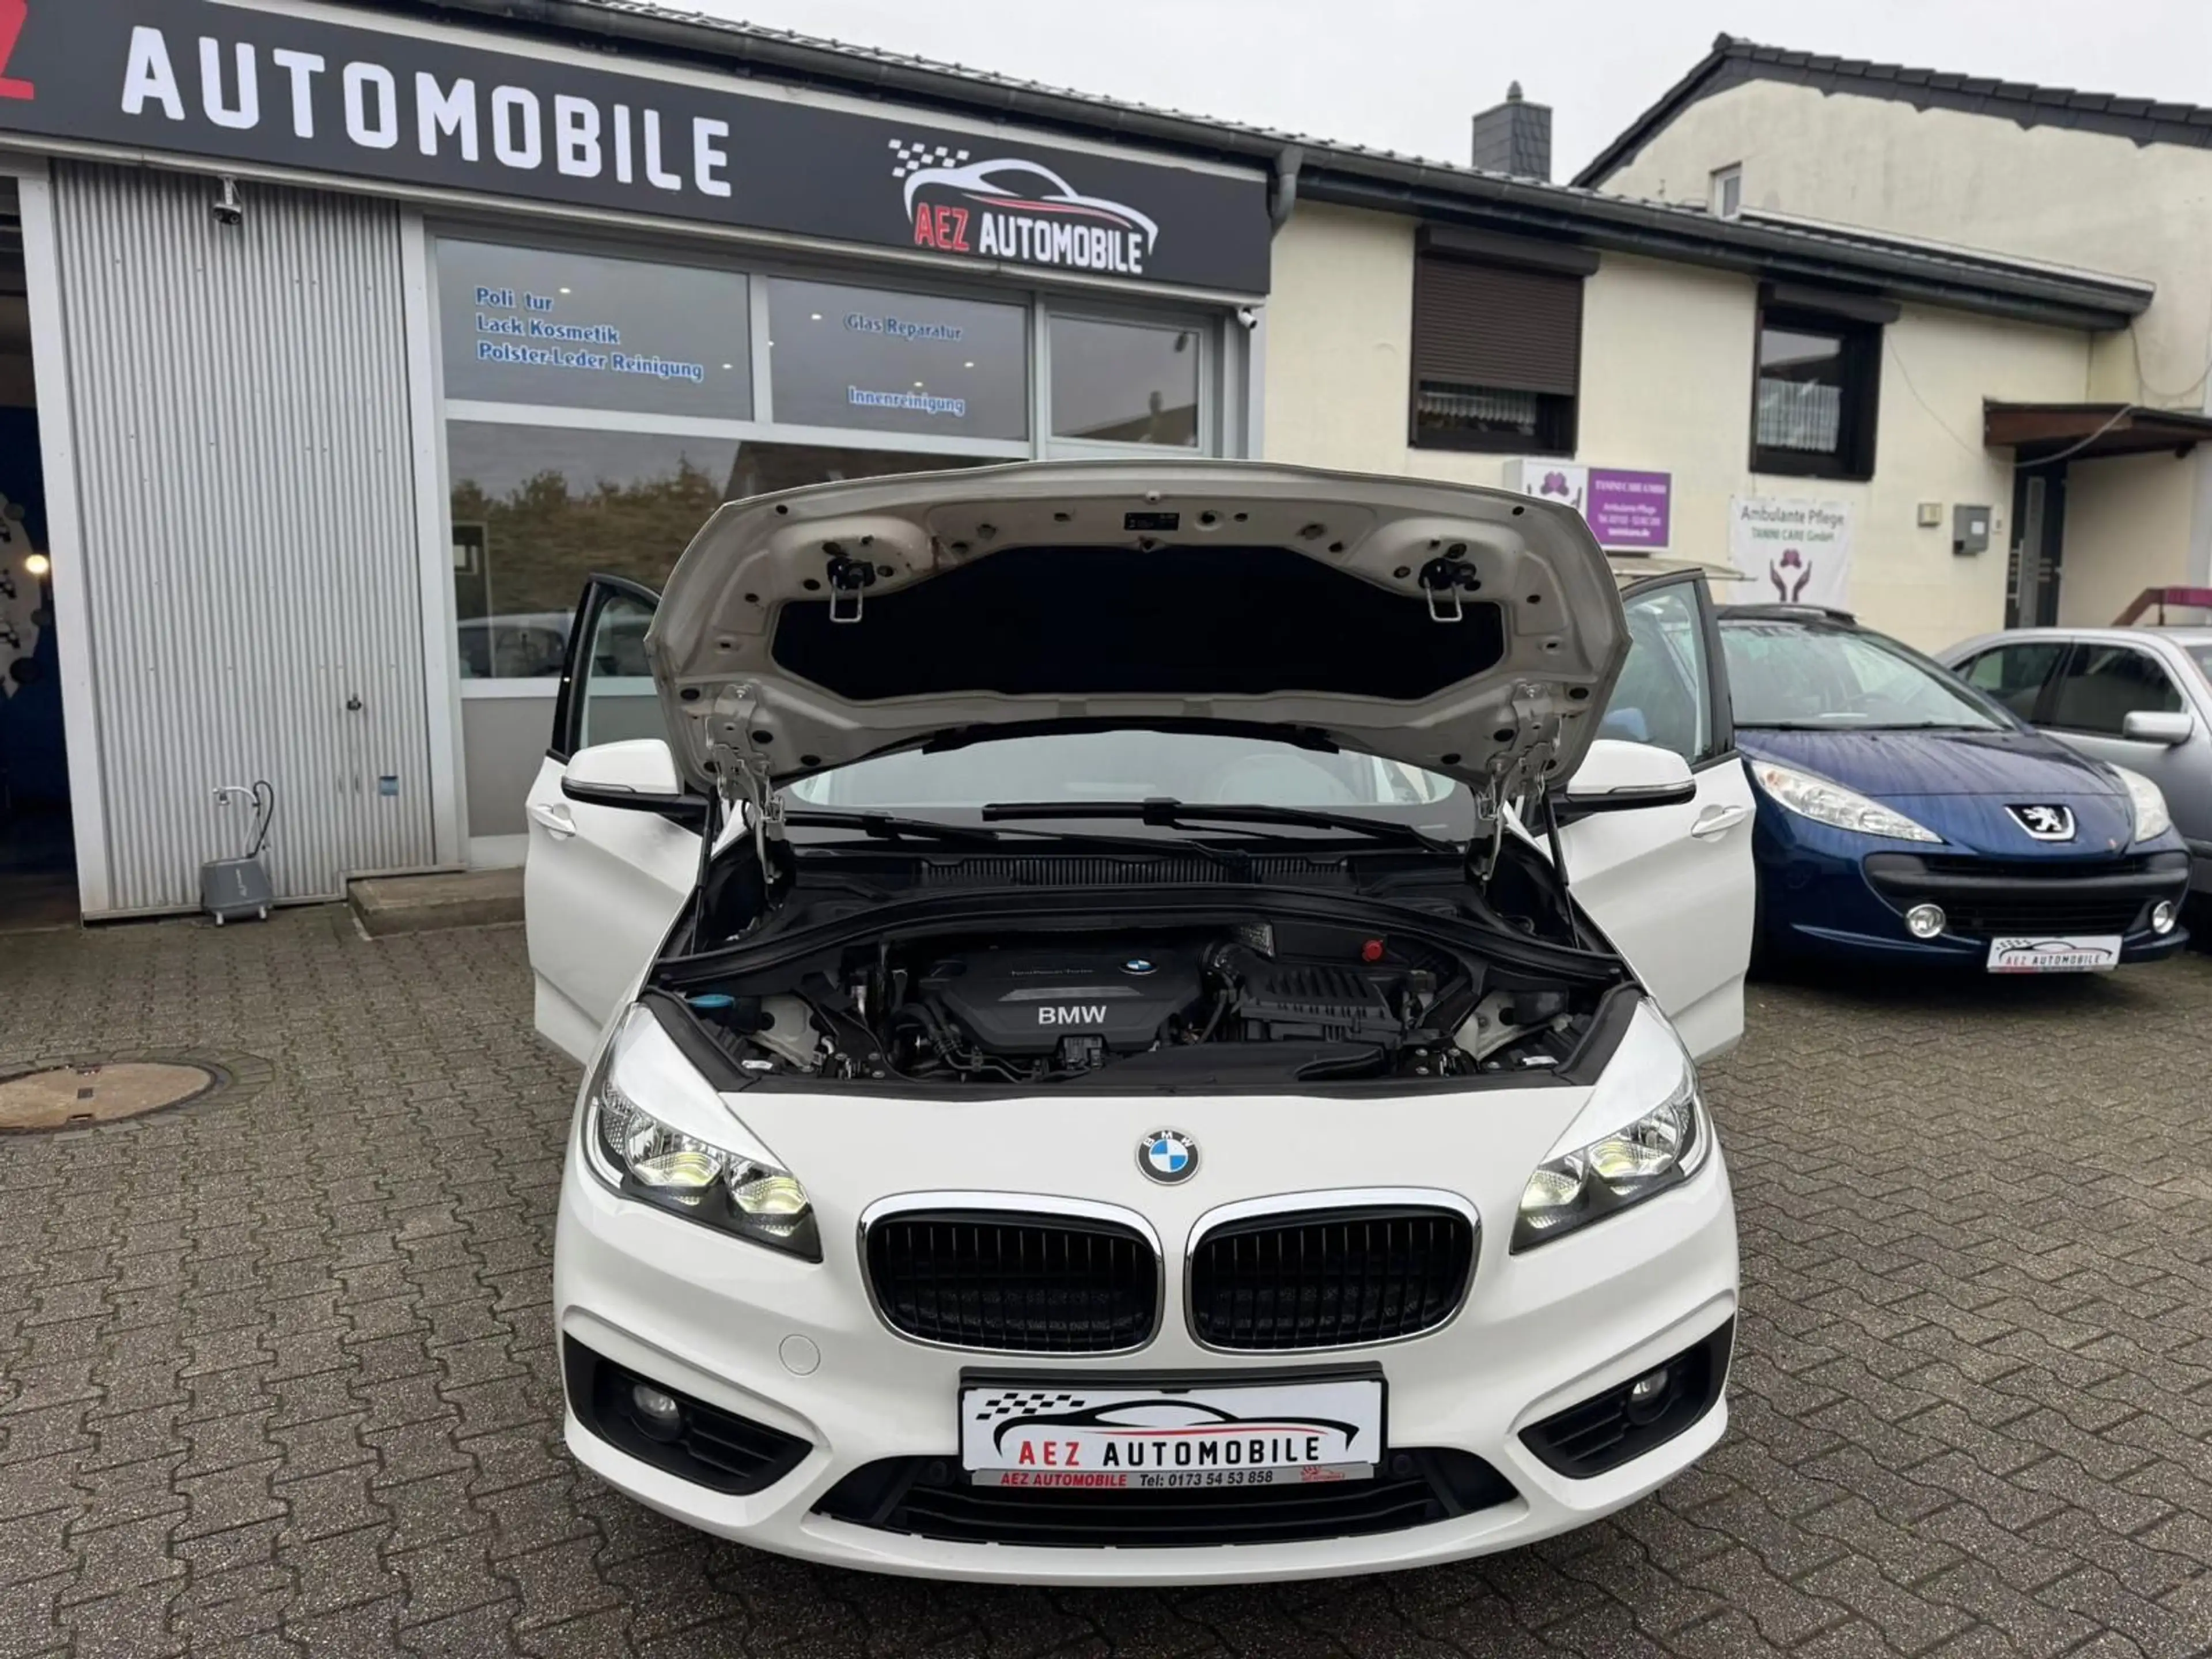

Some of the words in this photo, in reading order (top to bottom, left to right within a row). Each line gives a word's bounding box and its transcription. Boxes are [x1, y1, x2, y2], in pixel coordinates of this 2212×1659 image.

[122, 25, 732, 197] AUTOMOBILE
[914, 202, 969, 252] AEZ
[980, 211, 1142, 274] AUTOMOBILE
[476, 314, 525, 335] Lack
[528, 319, 620, 344] Kosmetik
[846, 313, 882, 332] Glas
[885, 316, 963, 340] Reparatur
[611, 353, 703, 382] Reinigung
[848, 385, 965, 416] Innenreinigung
[1039, 1006, 1107, 1024] BMW
[1143, 1130, 1194, 1147] BMW
[1018, 1441, 1080, 1466] AEZ
[1103, 1437, 1320, 1467] AUTOMOBILE
[1001, 1473, 1029, 1485] AEZ
[1032, 1475, 1127, 1487] AUTOMOBILE
[1140, 1474, 1164, 1487] Tel:
[1168, 1473, 1202, 1486] 0173
[1205, 1472, 1225, 1485] 54
[1227, 1471, 1244, 1484] 53
[1247, 1471, 1274, 1483] 858
